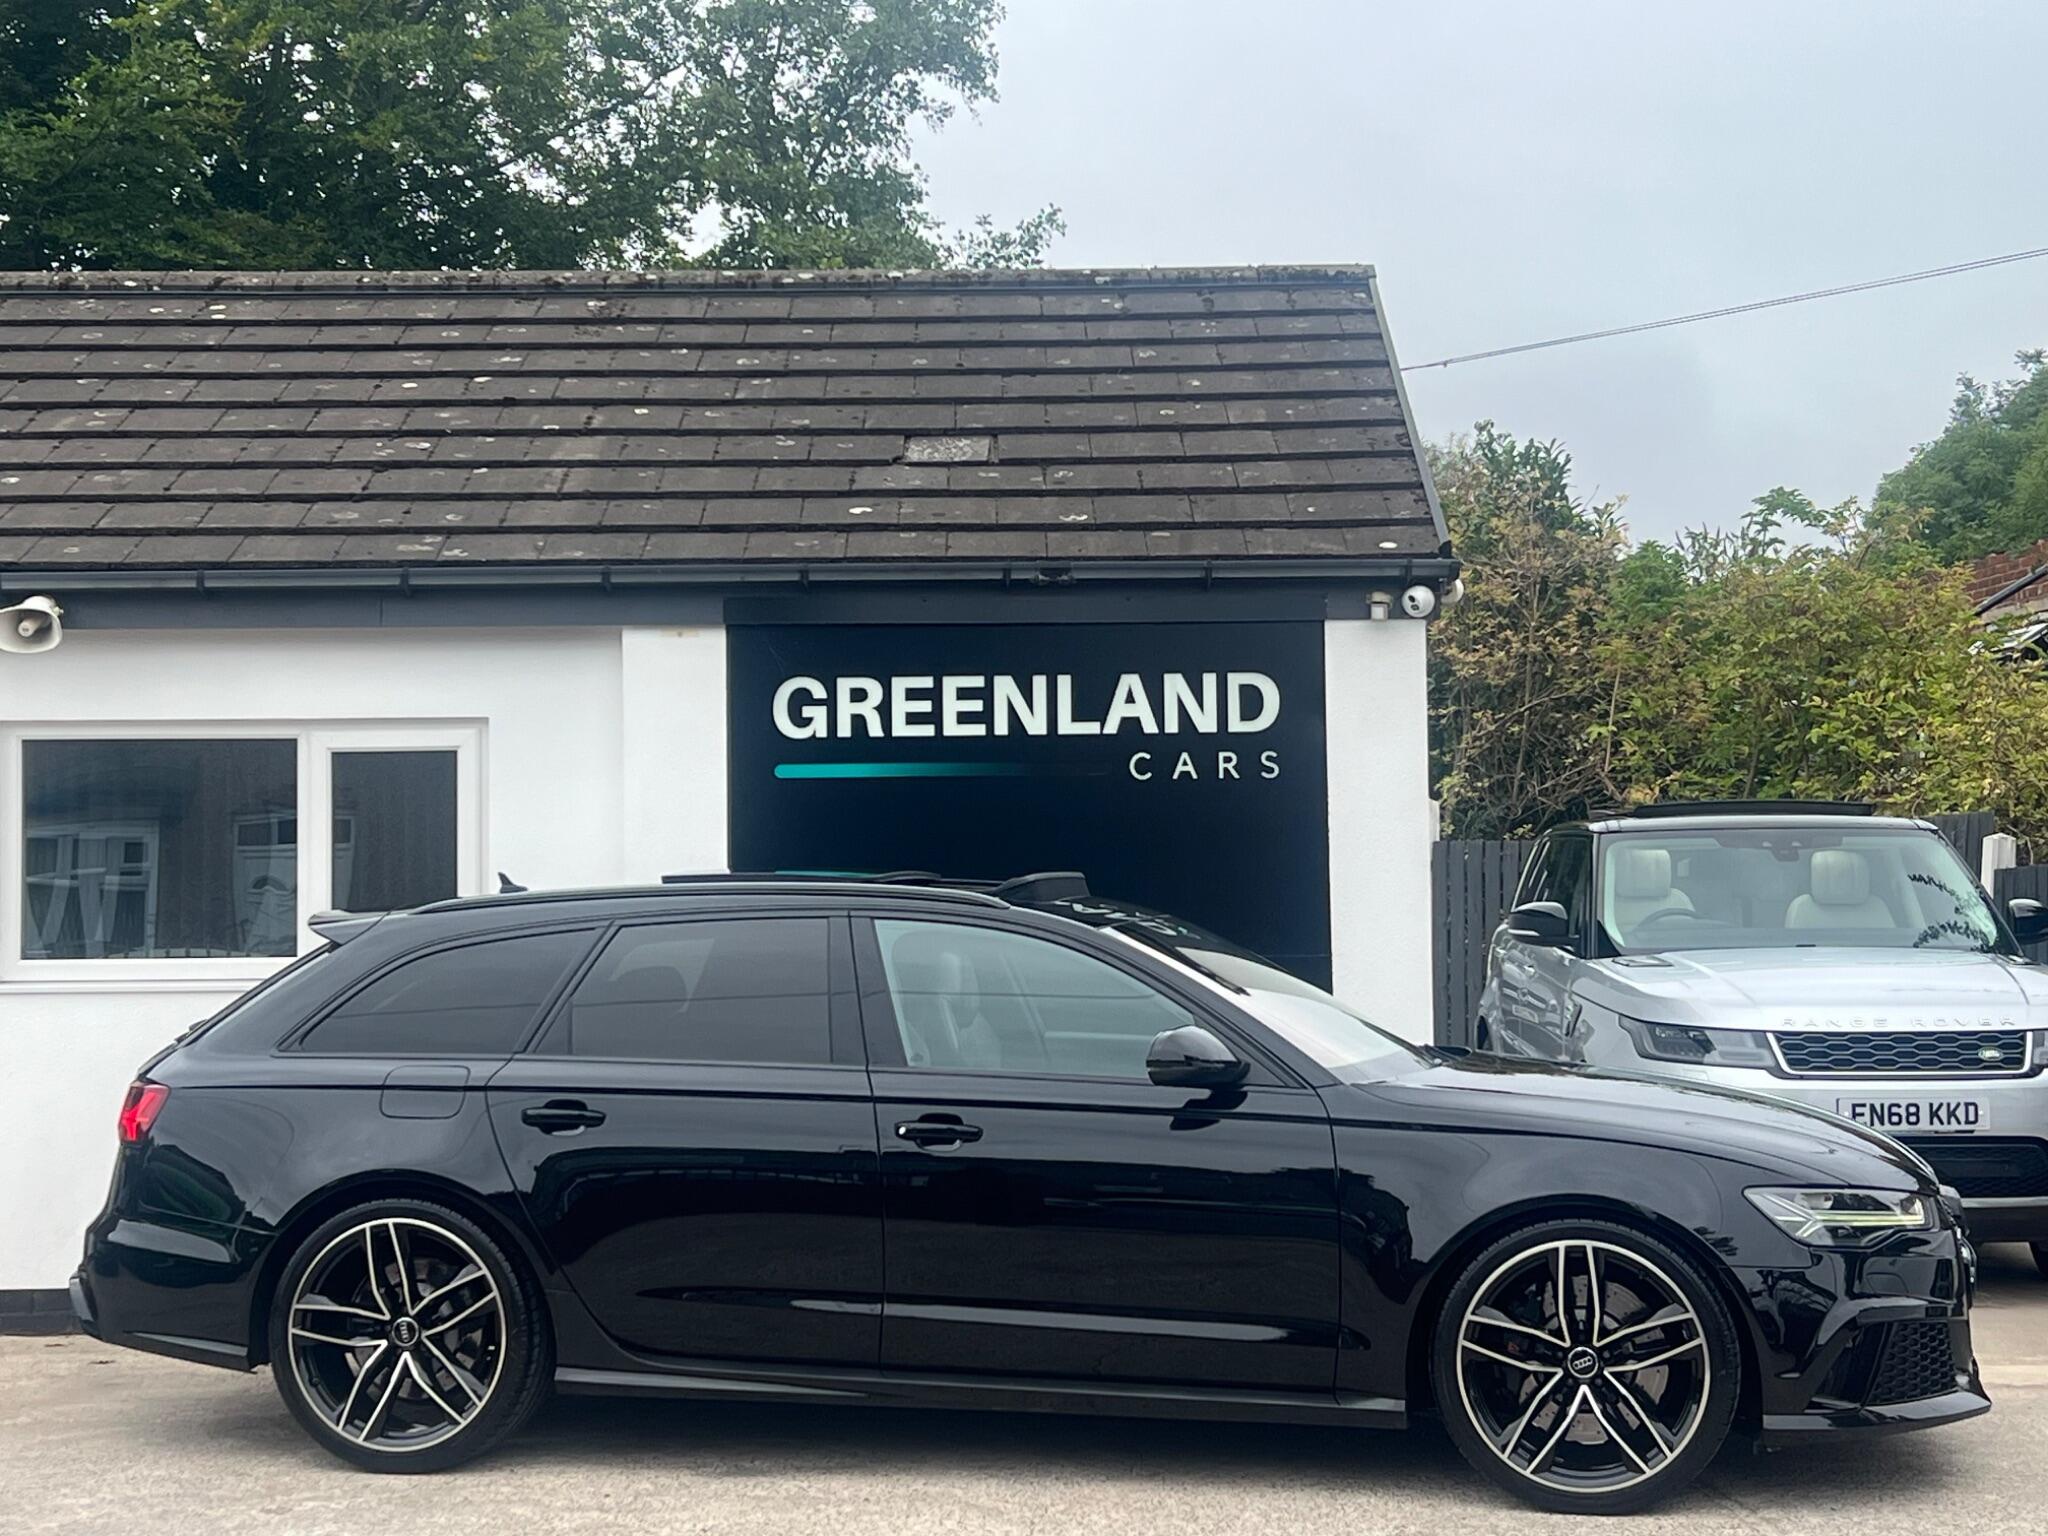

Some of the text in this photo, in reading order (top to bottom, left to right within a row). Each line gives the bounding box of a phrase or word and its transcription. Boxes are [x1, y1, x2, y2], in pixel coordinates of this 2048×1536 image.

[772, 672, 1281, 740] GREENLAND
[1129, 750, 1280, 781] CARS
[1781, 1016, 2016, 1028] RANGE ROVER
[1851, 1101, 1979, 1127] EN68 KKD
